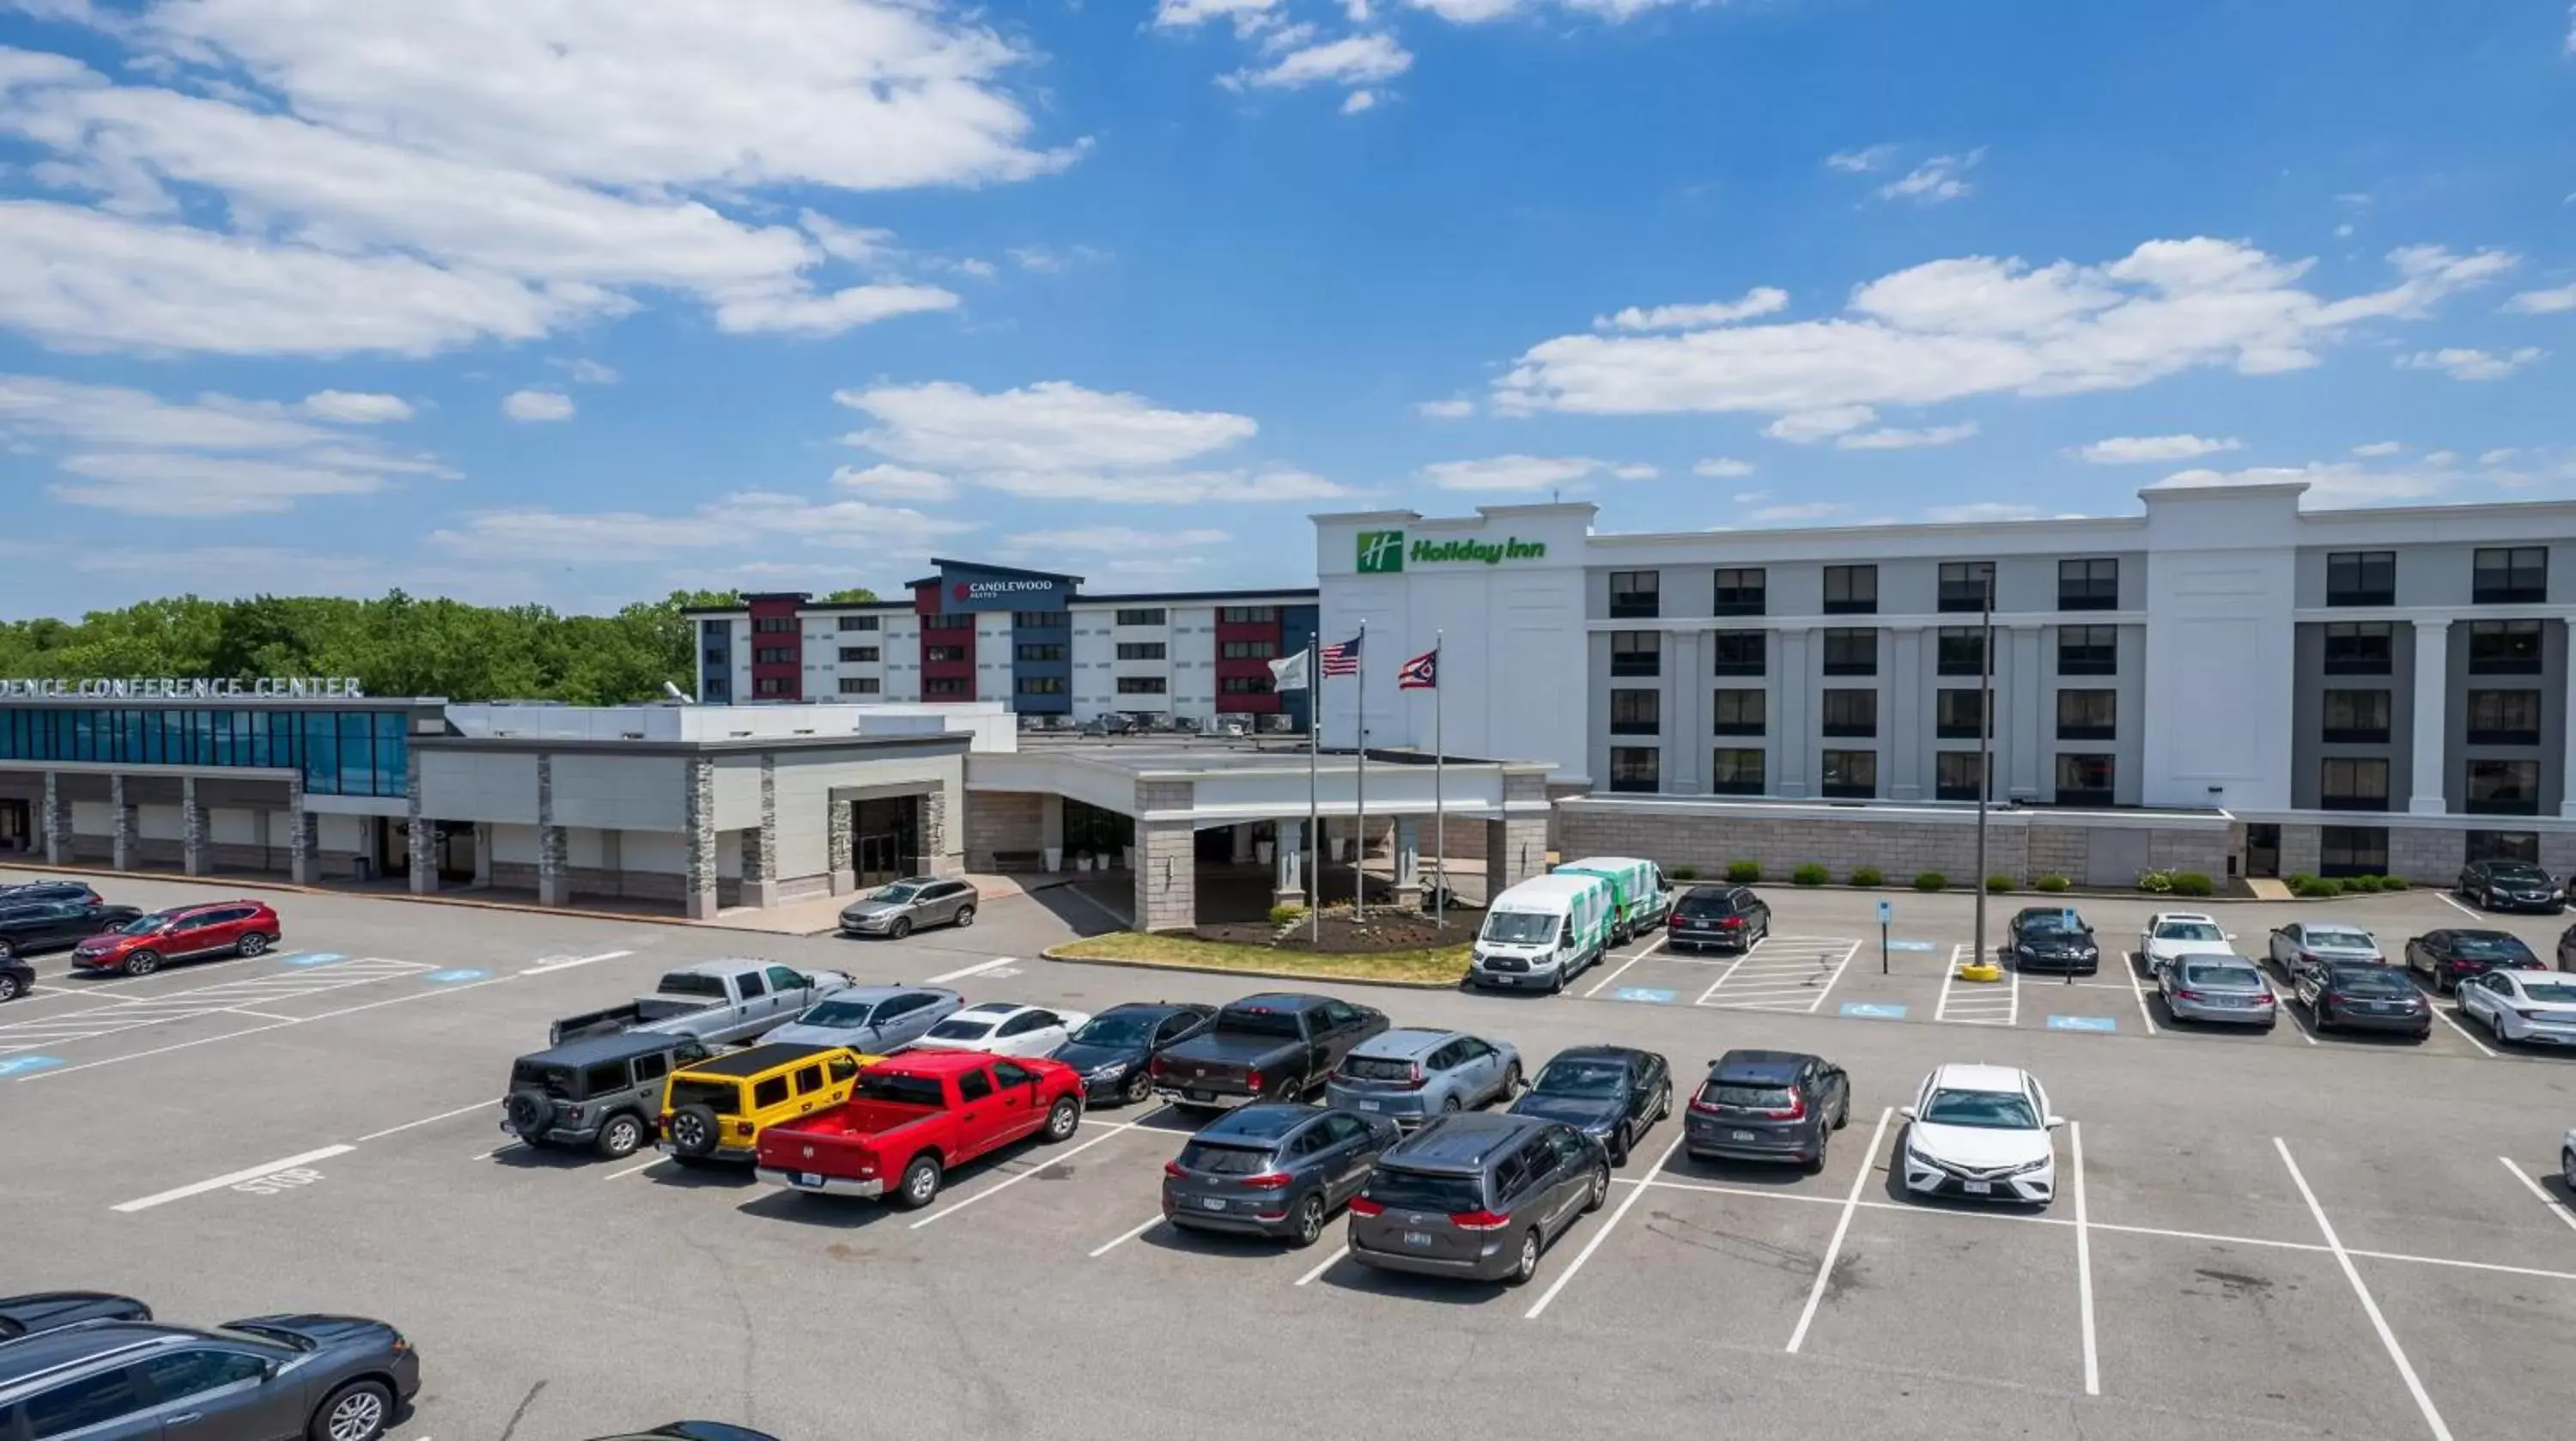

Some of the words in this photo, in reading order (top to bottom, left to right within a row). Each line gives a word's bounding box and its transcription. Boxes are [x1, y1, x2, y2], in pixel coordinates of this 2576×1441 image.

[1410, 538, 1504, 564] Holiday
[1505, 537, 1546, 558] Inn
[969, 581, 1053, 592] CANDLEWOOD
[78, 677, 243, 698] CONFERENCE
[255, 677, 365, 698] CENTER
